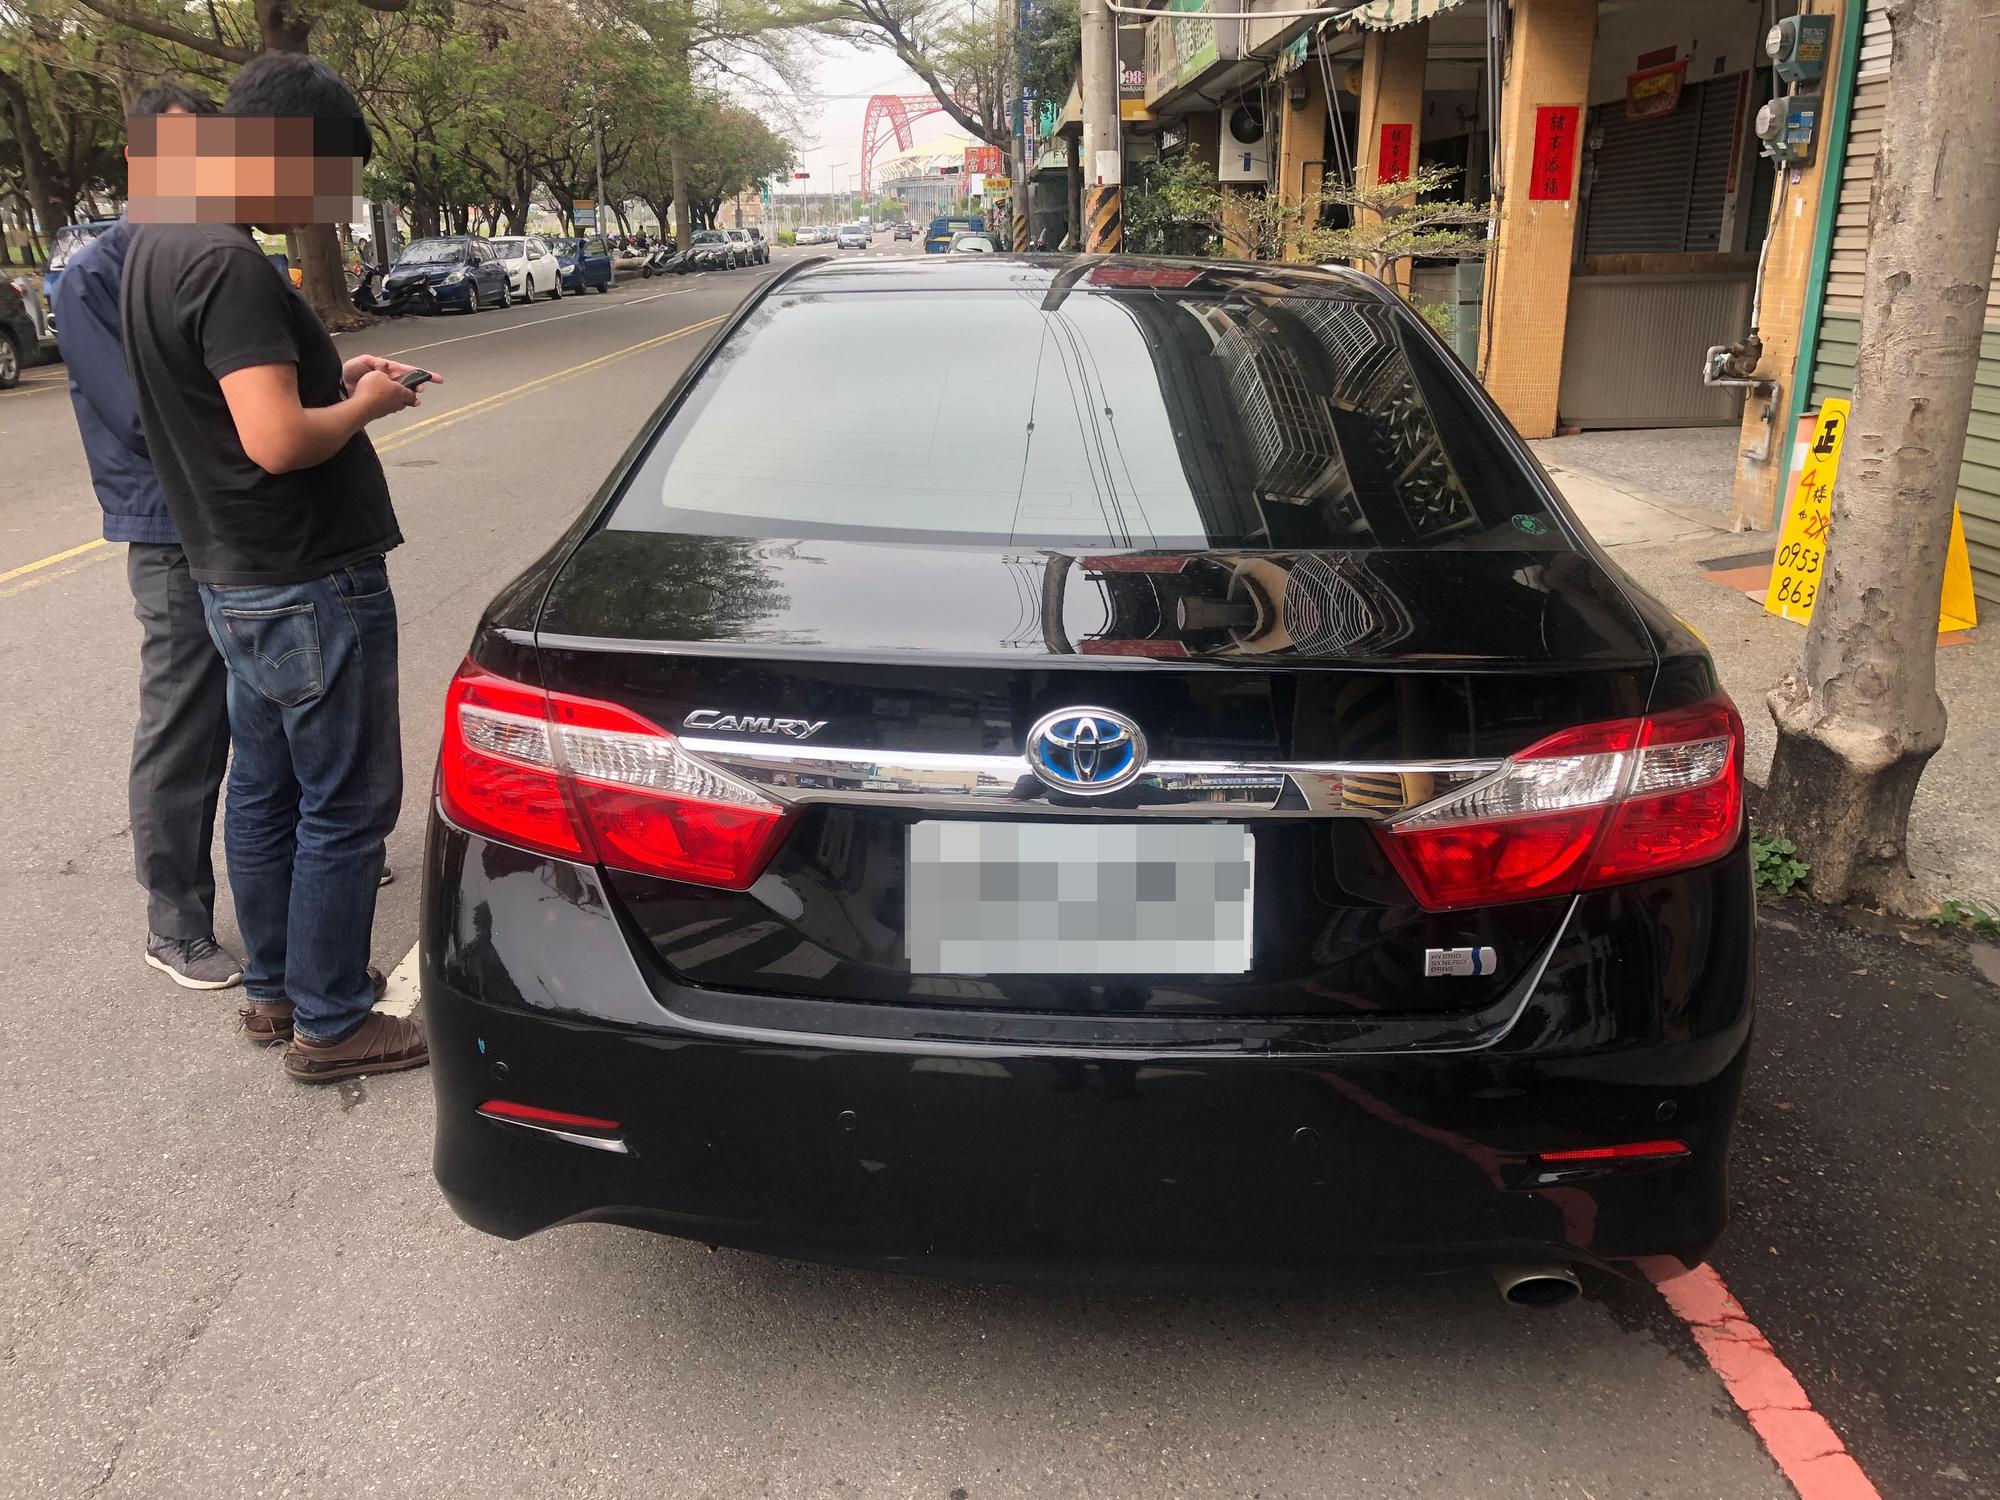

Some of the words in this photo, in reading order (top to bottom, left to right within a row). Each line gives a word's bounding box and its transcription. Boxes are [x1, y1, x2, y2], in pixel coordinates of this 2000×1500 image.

[1778, 542, 1820, 574] 0953
[1777, 576, 1816, 608] 863
[683, 709, 829, 740] CAMRY
